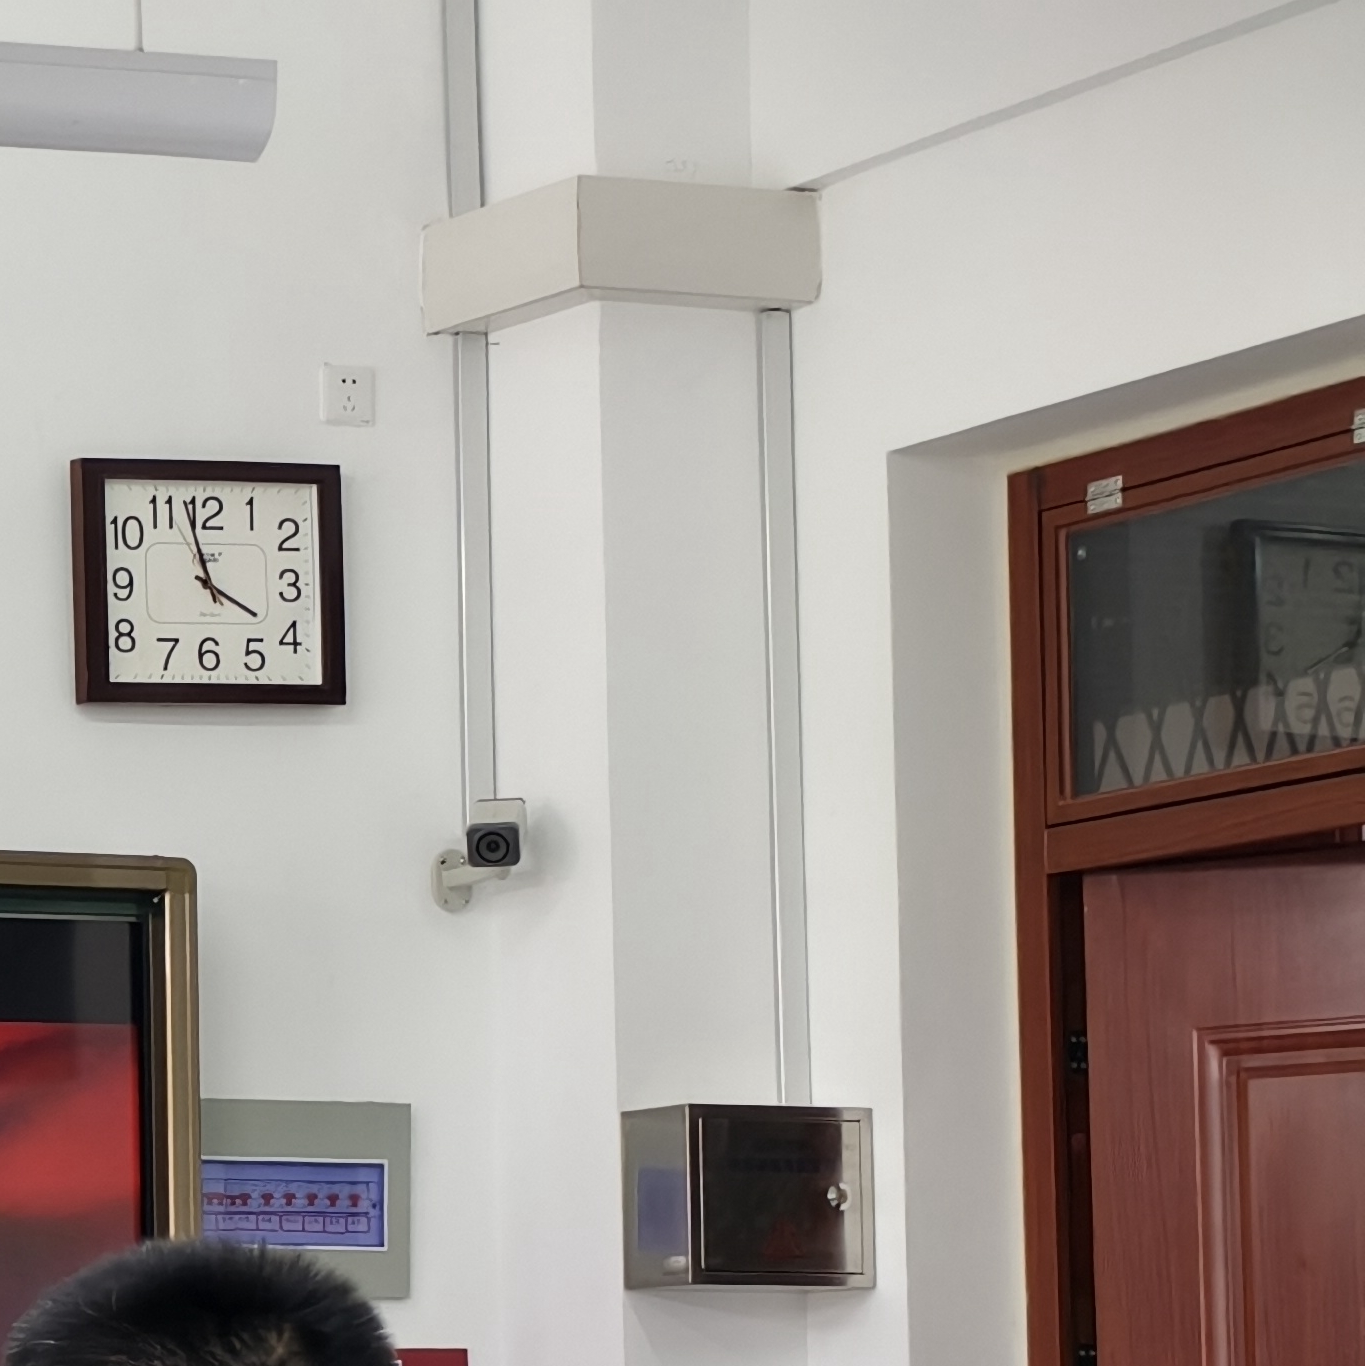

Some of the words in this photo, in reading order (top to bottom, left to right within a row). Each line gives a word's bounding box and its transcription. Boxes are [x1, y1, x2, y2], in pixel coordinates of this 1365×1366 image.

[149, 495, 173, 529] 11
[188, 496, 224, 530] 12
[245, 497, 254, 531] 1
[110, 516, 144, 550] 10
[277, 518, 300, 552] 2
[112, 567, 134, 601] 9
[278, 569, 301, 602] 3
[114, 618, 136, 653] 8
[279, 620, 302, 654] 4
[157, 638, 179, 671] 7
[198, 637, 220, 671] 6
[244, 638, 265, 672] 5
